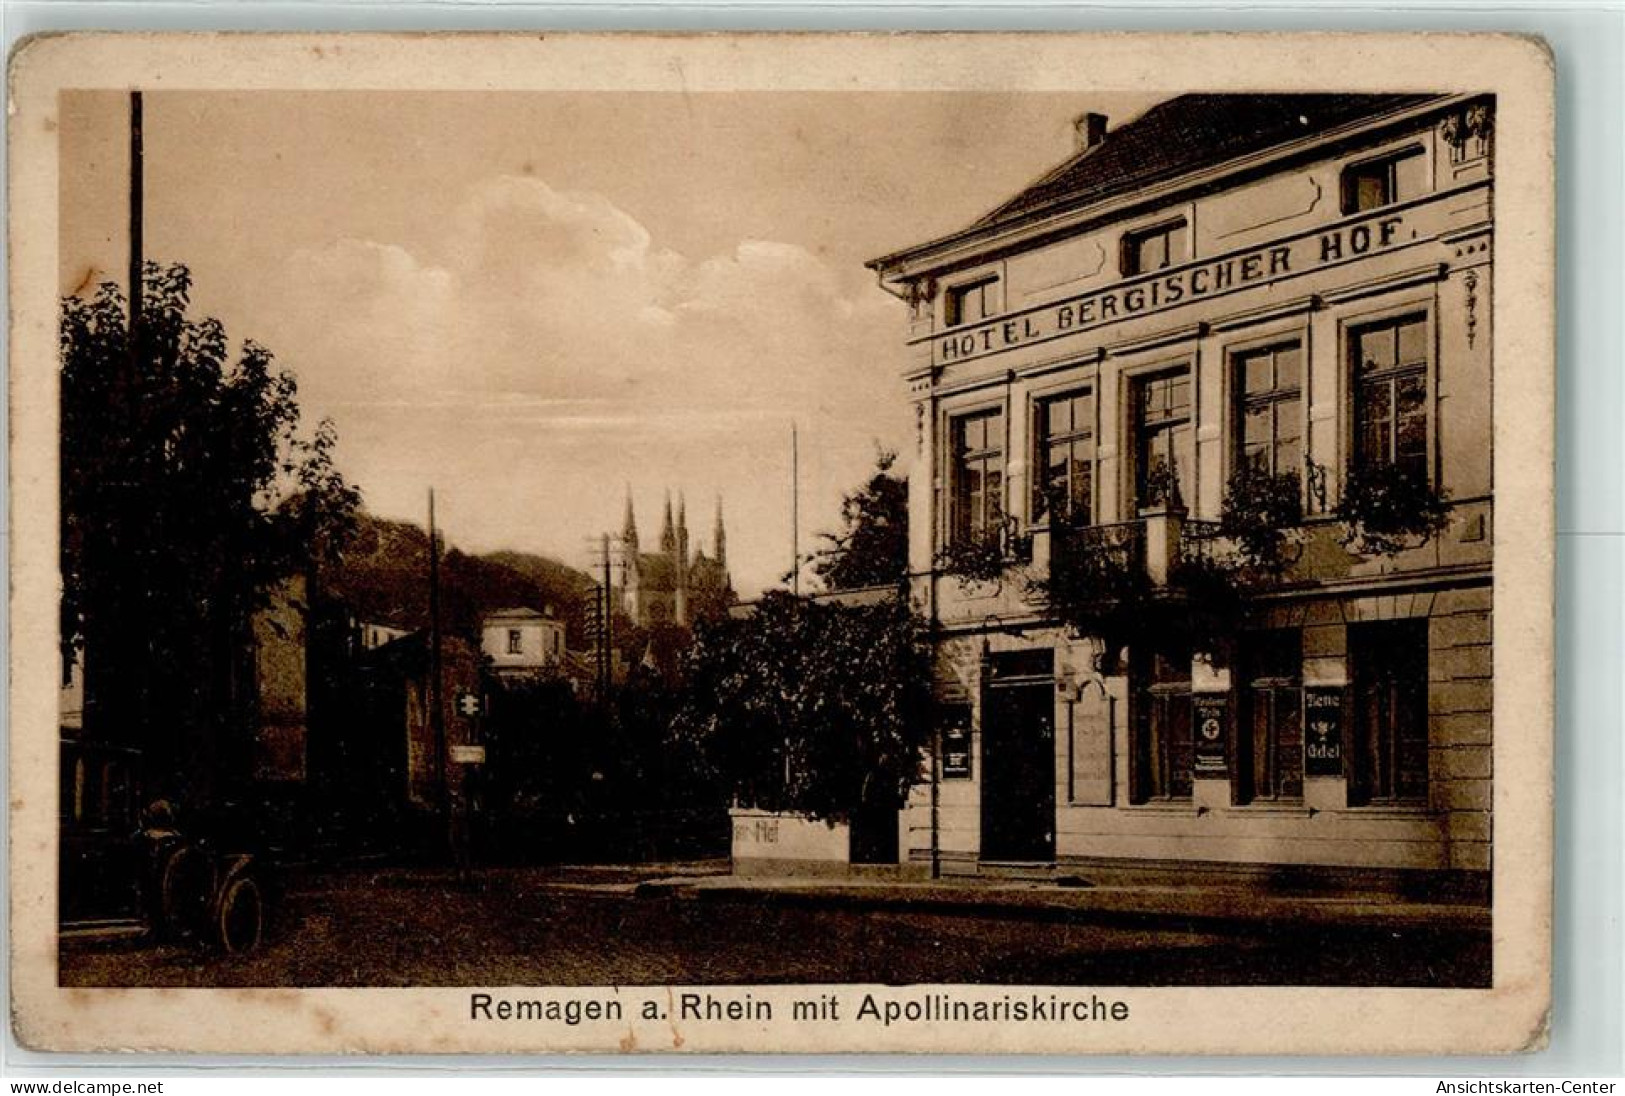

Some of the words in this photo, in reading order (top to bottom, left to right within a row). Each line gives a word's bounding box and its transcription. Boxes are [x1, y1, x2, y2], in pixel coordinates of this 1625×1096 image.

[942, 317, 1040, 360] HOTEL
[1057, 245, 1292, 330] BERGISCHER
[472, 994, 621, 1025] Remagen
[643, 1002, 666, 1019] a.
[682, 994, 771, 1019] Rhein
[794, 995, 838, 1019] mit
[857, 995, 1128, 1025] Apollinariskirche
